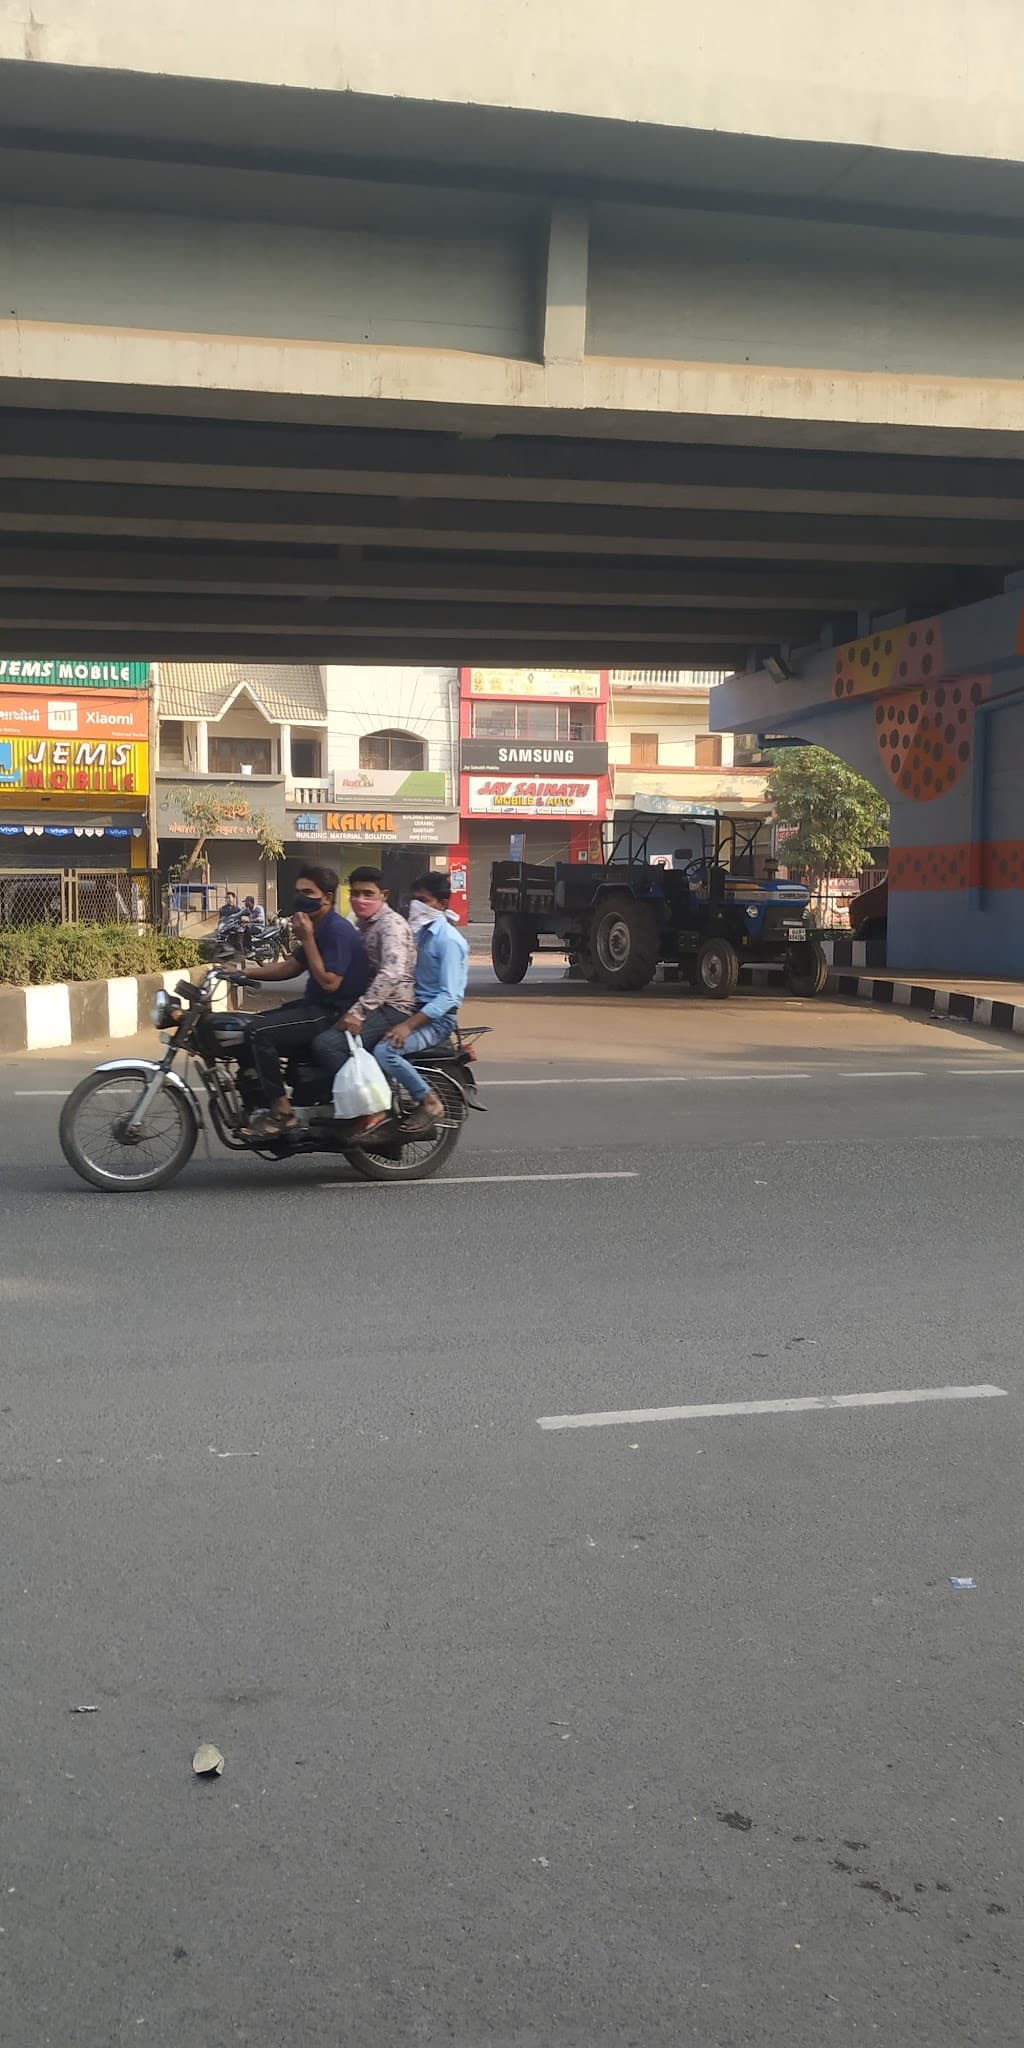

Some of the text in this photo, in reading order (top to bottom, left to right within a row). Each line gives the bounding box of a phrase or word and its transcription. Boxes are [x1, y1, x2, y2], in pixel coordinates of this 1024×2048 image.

[0, 661, 129, 681] JEMS MOBILE
[86, 711, 134, 725] Xiaomi
[27, 741, 132, 766] JEMS
[498, 748, 574, 763] SAMSUNG
[25, 769, 135, 792] MOBILE
[479, 781, 590, 798] JAY SAINATH
[494, 796, 576, 807] MOBILE & AUTO
[326, 812, 397, 832] KAMAL
[330, 832, 362, 840] MATERIAL
